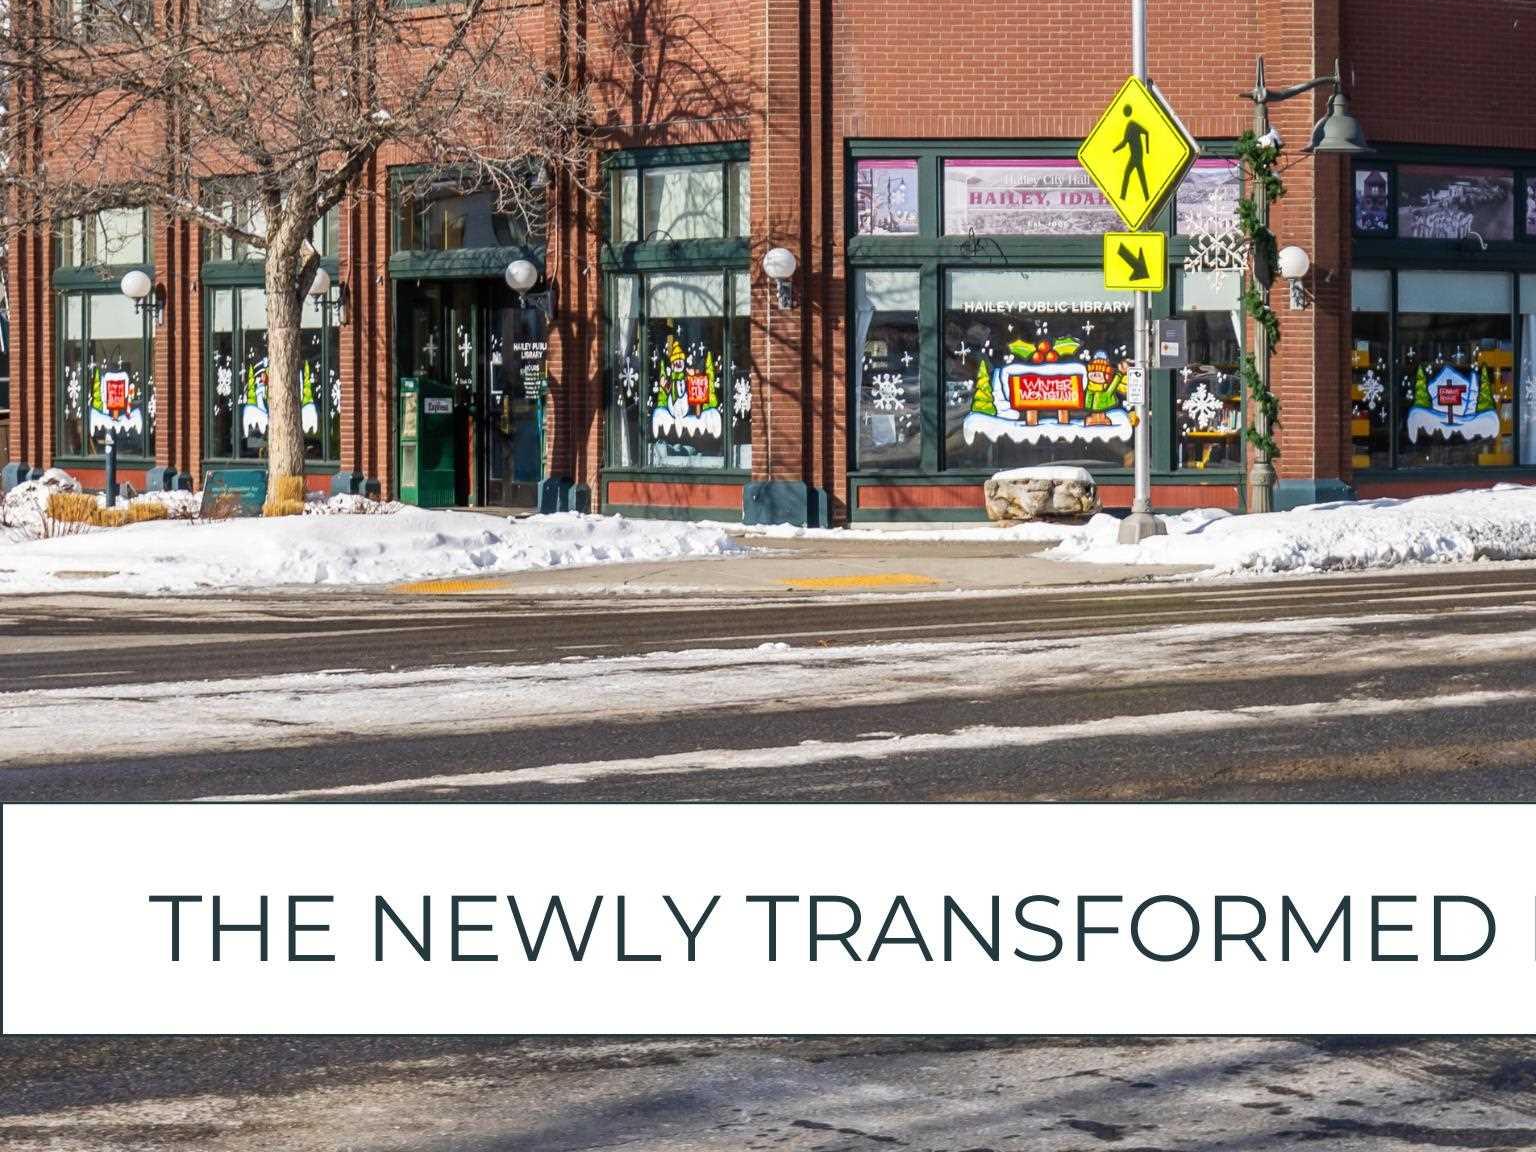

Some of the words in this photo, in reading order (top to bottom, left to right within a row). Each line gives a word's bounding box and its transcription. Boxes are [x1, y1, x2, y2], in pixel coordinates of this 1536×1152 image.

[969, 191, 1050, 206] HAILEY,
[964, 301, 1016, 313] HAILEY
[1018, 301, 1068, 313] PUBLIC
[1071, 301, 1131, 313] LIBRARY
[1023, 378, 1072, 391] WINTER
